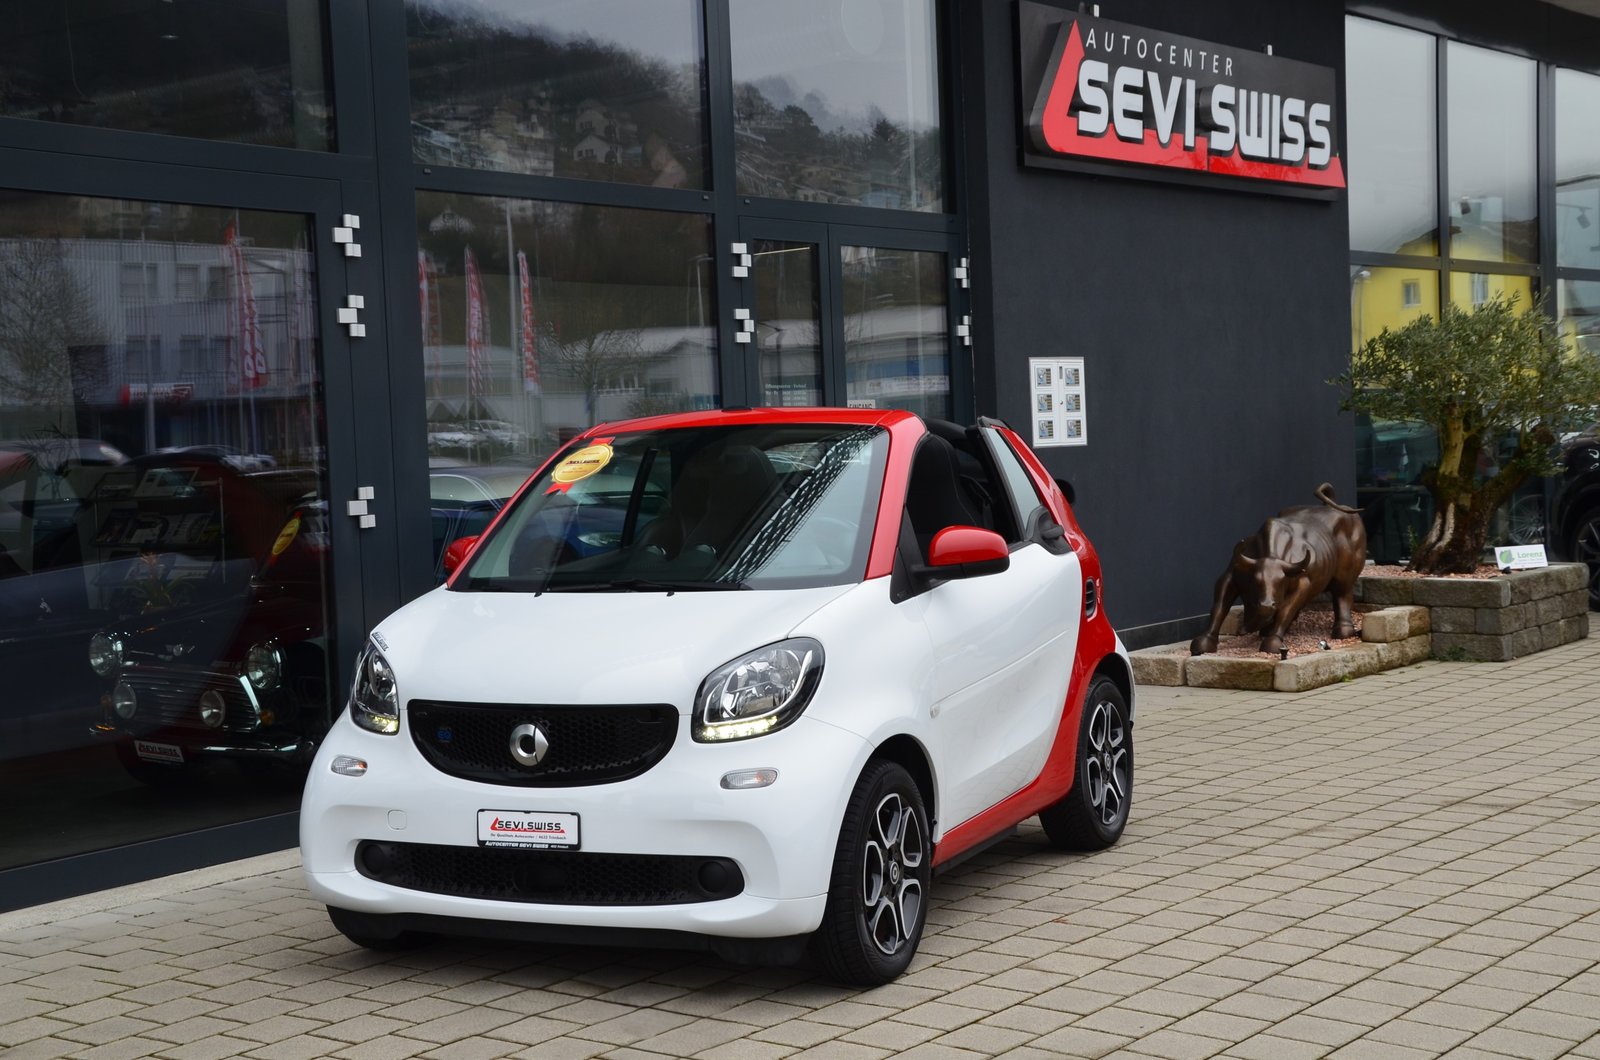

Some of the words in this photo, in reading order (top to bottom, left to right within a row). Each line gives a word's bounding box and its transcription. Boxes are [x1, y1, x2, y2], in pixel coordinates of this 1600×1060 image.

[1086, 27, 1233, 77] AUTOCENTER
[1077, 59, 1197, 150] SEVI
[1210, 84, 1331, 167] SWISS
[497, 820, 524, 830] SEVI
[527, 822, 562, 831] SWISS
